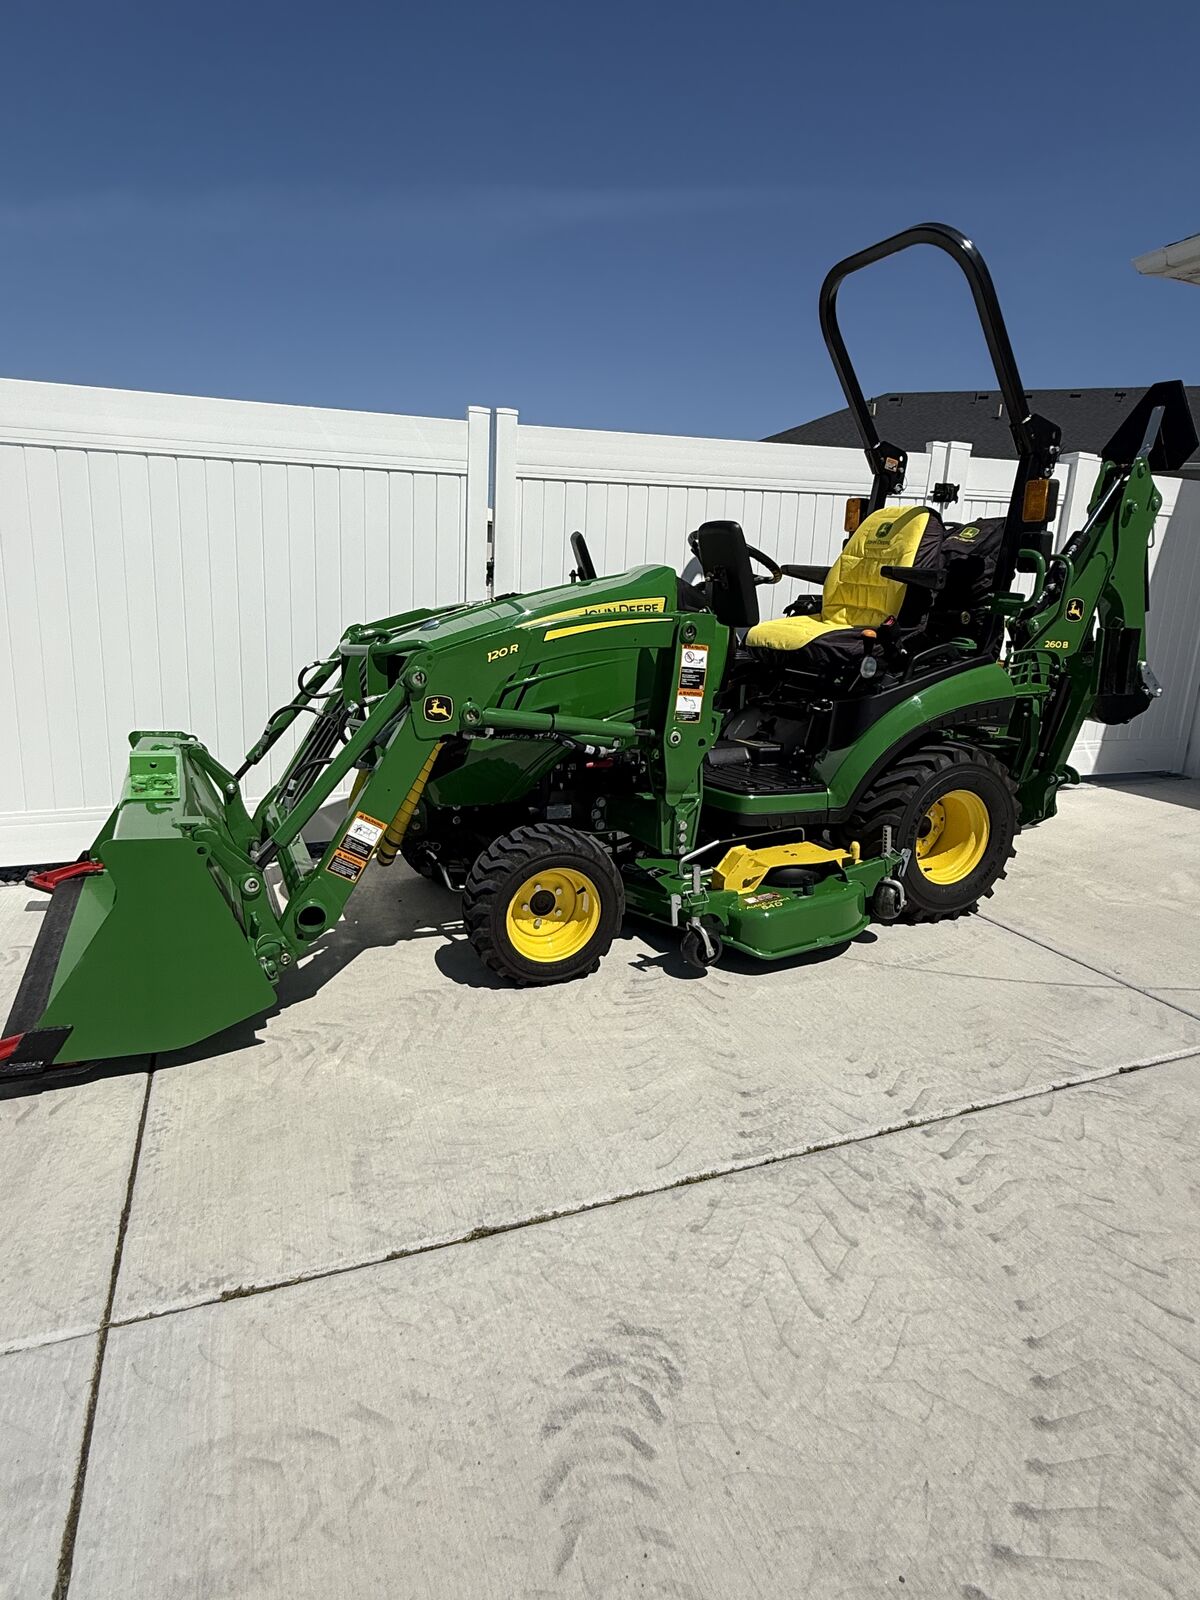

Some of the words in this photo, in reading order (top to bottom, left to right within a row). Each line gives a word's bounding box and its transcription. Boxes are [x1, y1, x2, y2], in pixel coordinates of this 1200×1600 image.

[619, 603, 659, 612] DEERE
[1044, 640, 1062, 649] 260
[1062, 641, 1069, 649] B
[487, 647, 508, 663] 120
[510, 643, 519, 654] R
